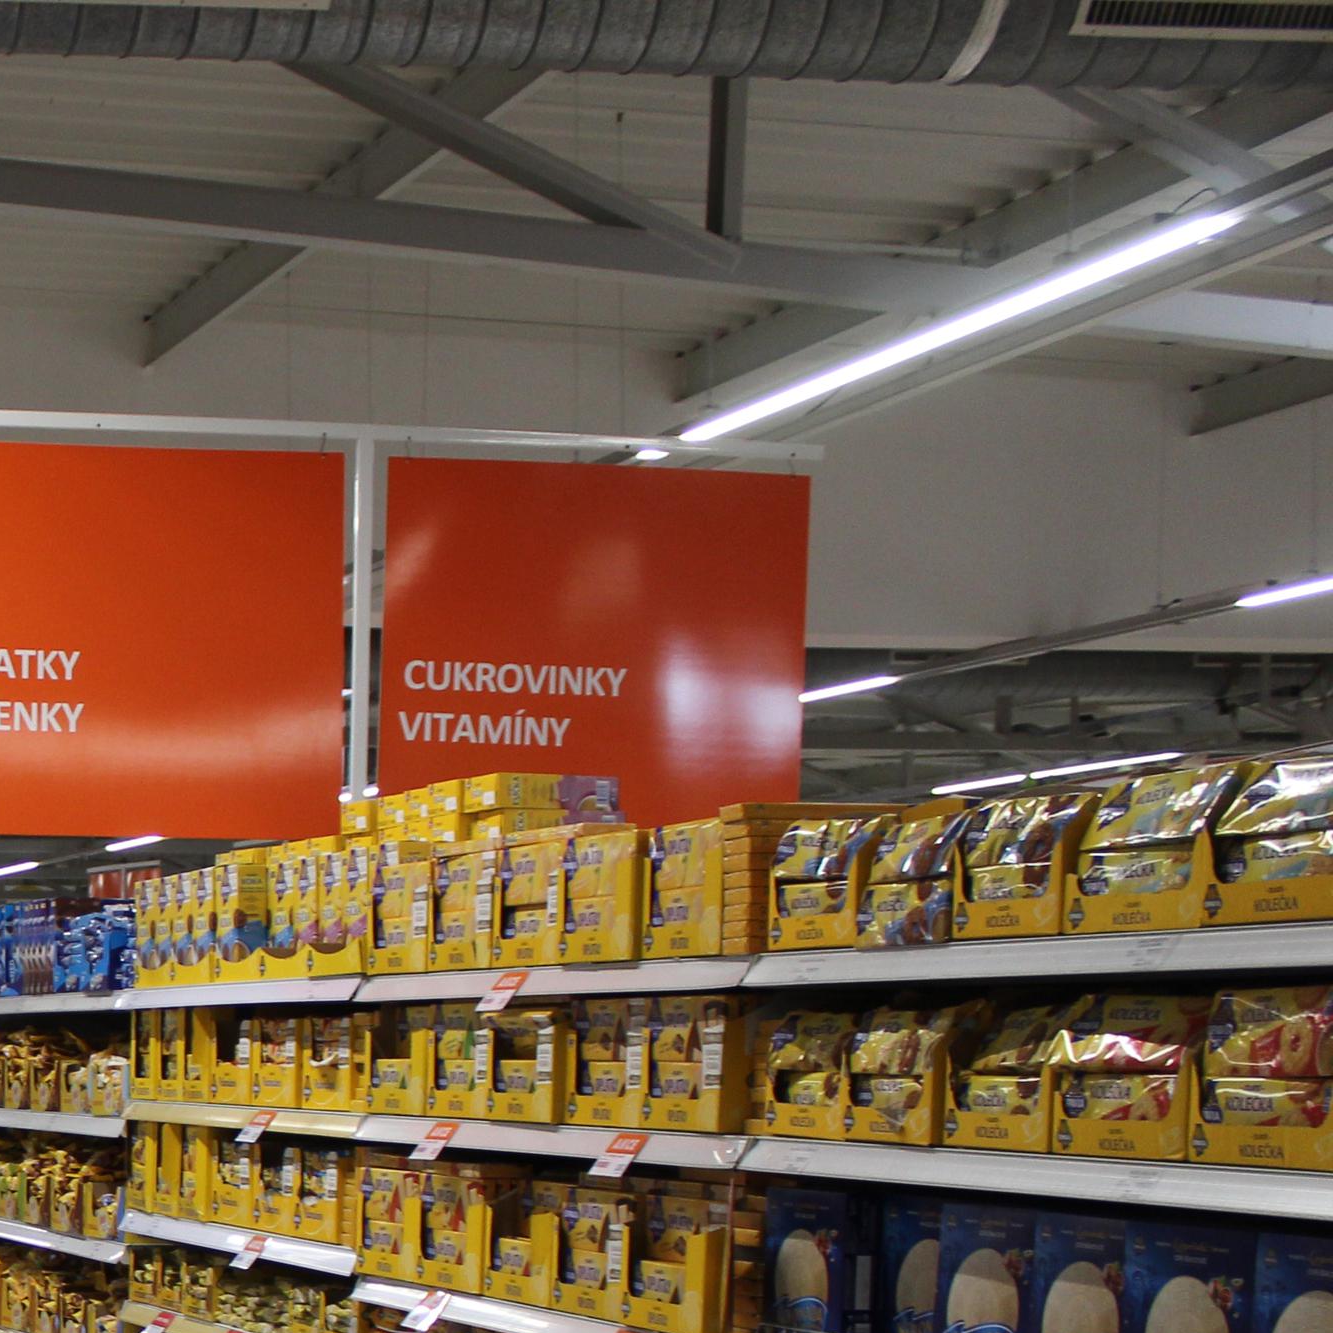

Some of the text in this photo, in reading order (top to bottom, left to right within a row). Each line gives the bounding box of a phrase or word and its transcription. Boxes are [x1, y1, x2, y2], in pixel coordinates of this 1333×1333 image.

[405, 660, 626, 696] CUKROVINKY
[399, 710, 569, 746] VITAMÍNY
[1254, 896, 1300, 912] KOLEČKA
[1238, 1142, 1286, 1160] KOLEČKA
